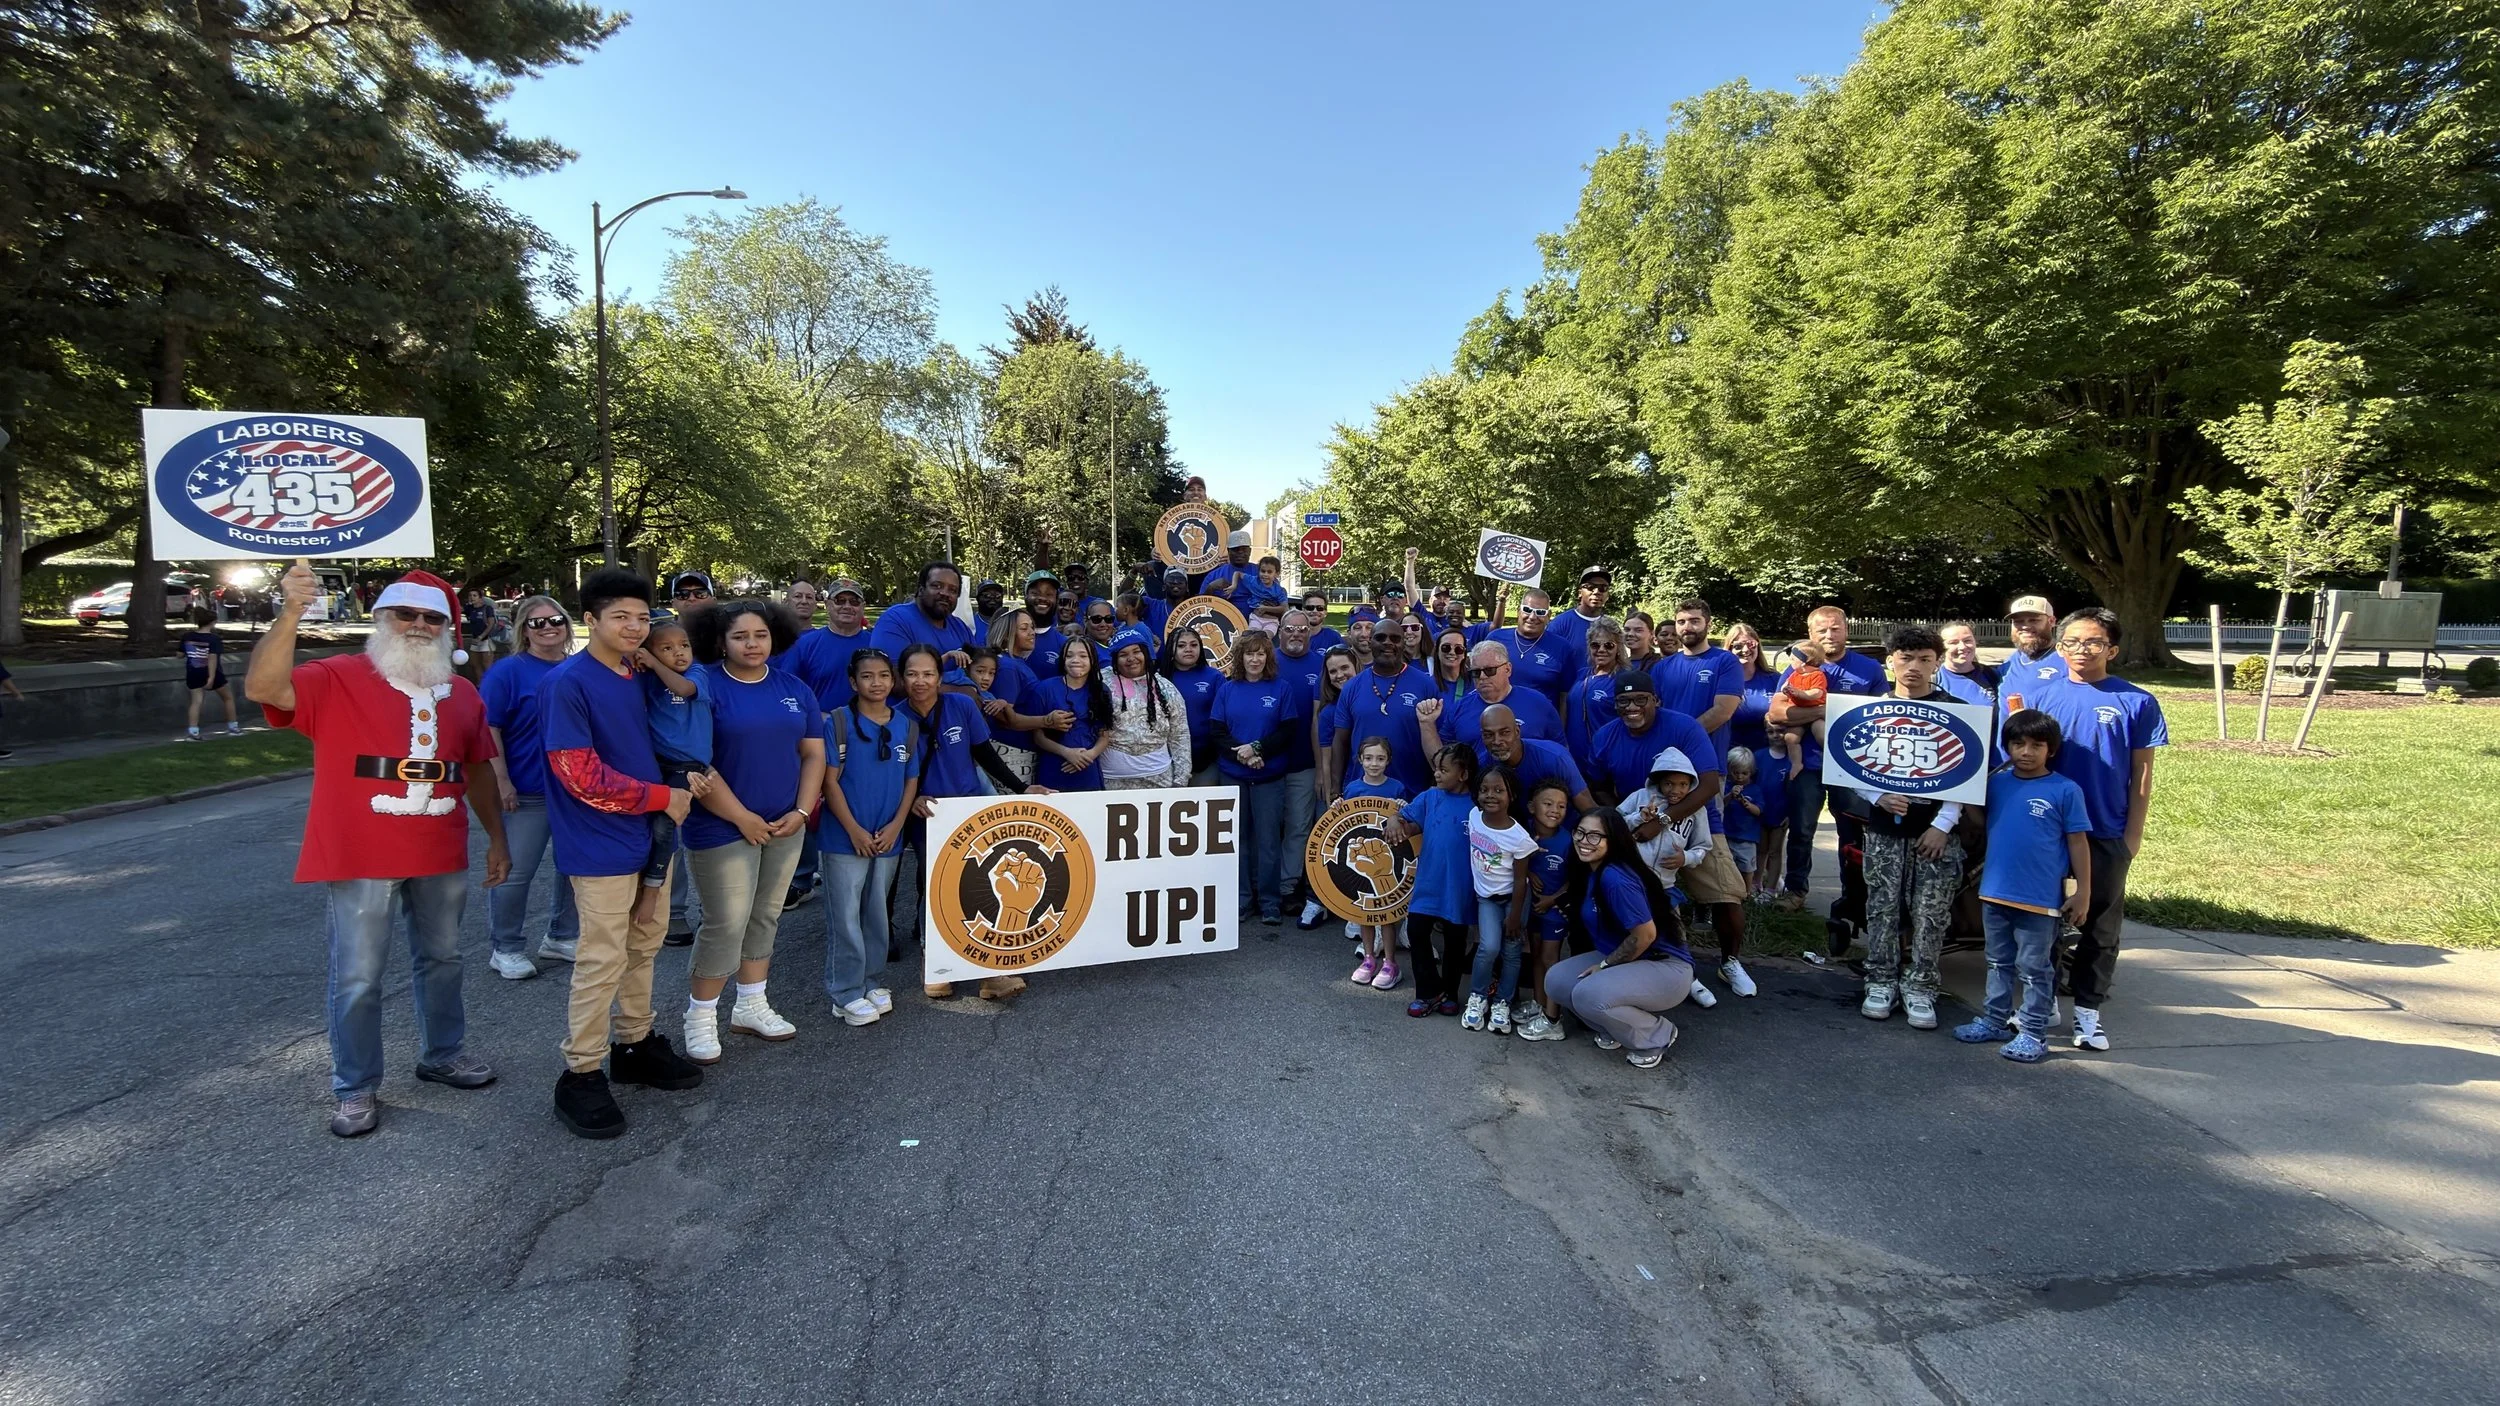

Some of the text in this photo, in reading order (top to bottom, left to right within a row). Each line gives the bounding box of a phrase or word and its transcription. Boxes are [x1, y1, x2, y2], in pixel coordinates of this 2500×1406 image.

[217, 422, 364, 446] LABORERS
[243, 454, 337, 468] LOCAL
[230, 471, 357, 517] 435
[1159, 504, 1217, 528] NEW ENGLAND REGION
[1173, 512, 1204, 525] LABORERS
[1310, 515, 1323, 523] East
[228, 527, 365, 546] Rochester, NY
[1497, 537, 1531, 550] LABORERS
[1183, 552, 1213, 564] RISING
[1303, 540, 1340, 556] STOP
[1496, 552, 1526, 570] 435
[1167, 597, 1213, 629] ENGLAND REGION
[1180, 608, 1202, 626] BORERS
[1863, 705, 1950, 724] LABORERS
[1876, 725, 1930, 737] LOCAL
[1866, 737, 1939, 770] 435
[1862, 769, 1920, 789] Rochester,
[1924, 779, 1941, 787] NY
[950, 805, 1079, 850] NEW ENGLAND REGION
[982, 824, 1050, 847] LABORERS
[1105, 798, 1236, 862] RISE
[1309, 841, 1319, 863] NEW
[1353, 799, 1390, 810] REGION
[1325, 814, 1369, 849] LABORERS
[1125, 885, 1217, 948] UP!
[1366, 914, 1387, 923] NEW
[982, 924, 1048, 947] RISING
[963, 933, 1066, 966] NEW YORK STATE
